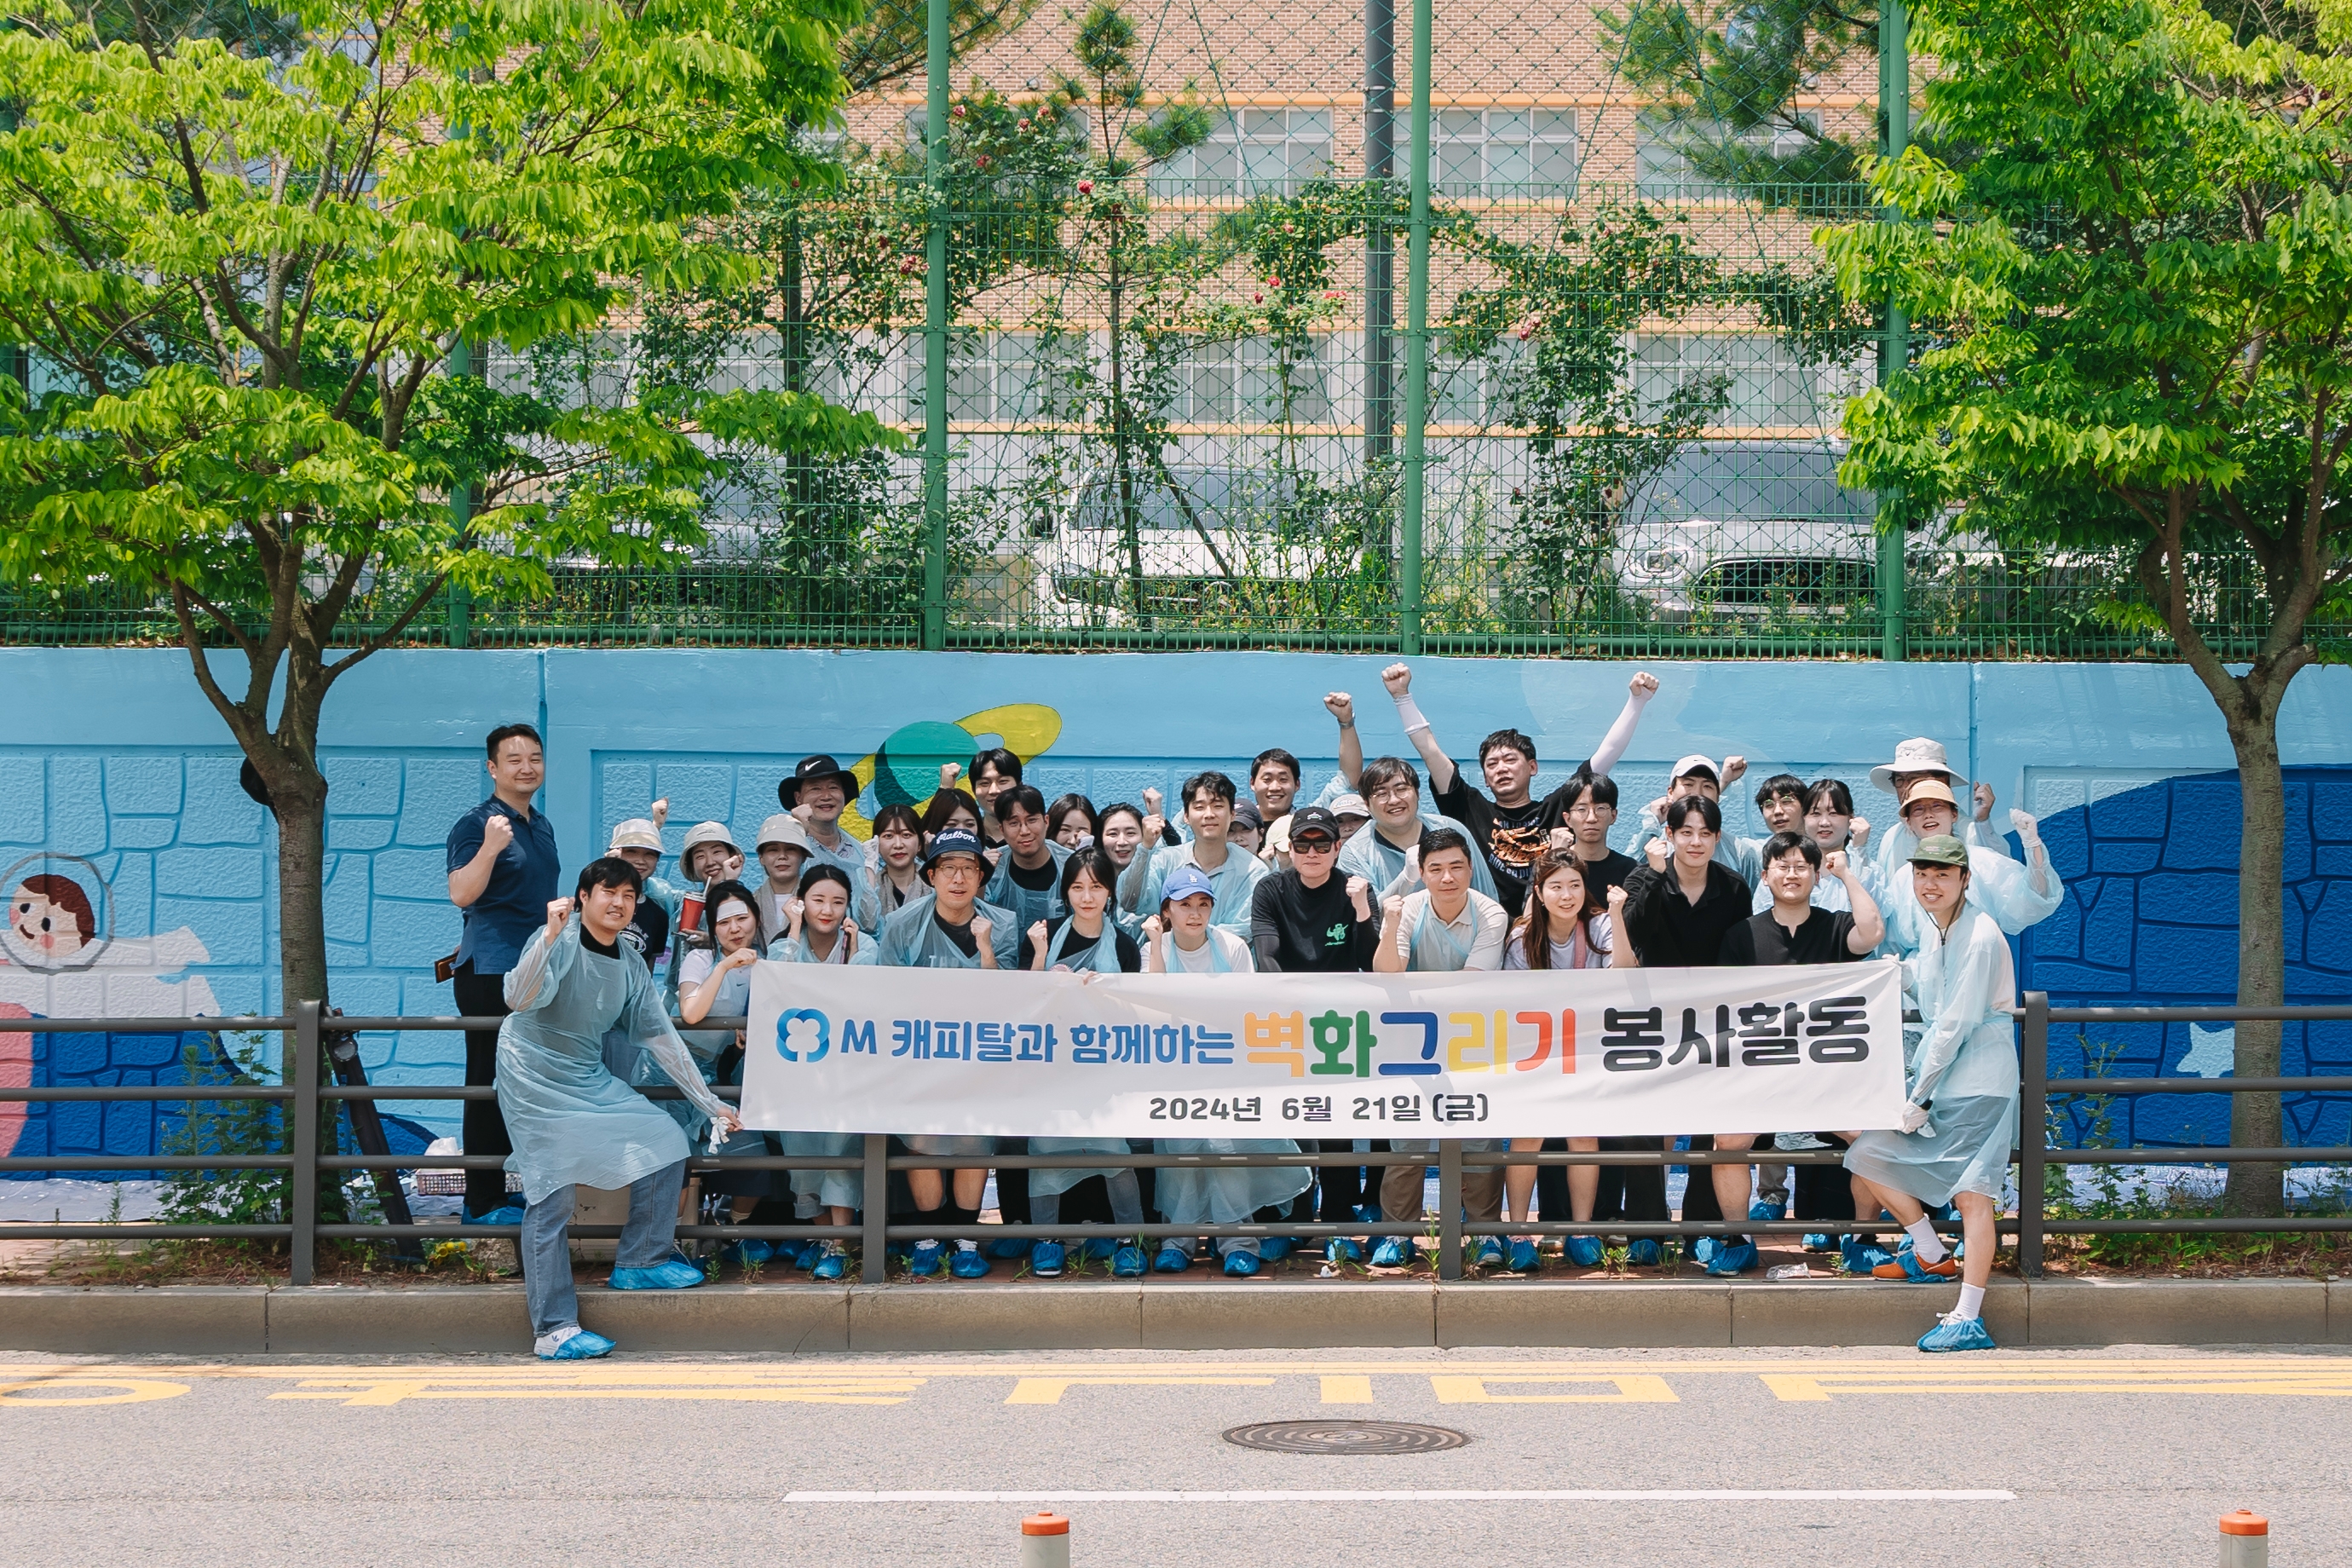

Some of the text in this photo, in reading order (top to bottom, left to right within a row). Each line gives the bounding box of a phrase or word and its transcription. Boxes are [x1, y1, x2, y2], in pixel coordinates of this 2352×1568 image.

[936, 830, 977, 845] Malbon
[840, 995, 1871, 1078] M 캐피탈과 함께하는 벽화그리기 봉사활동
[1150, 1096, 1261, 1121] 2024년
[1282, 1096, 1331, 1121] 6월
